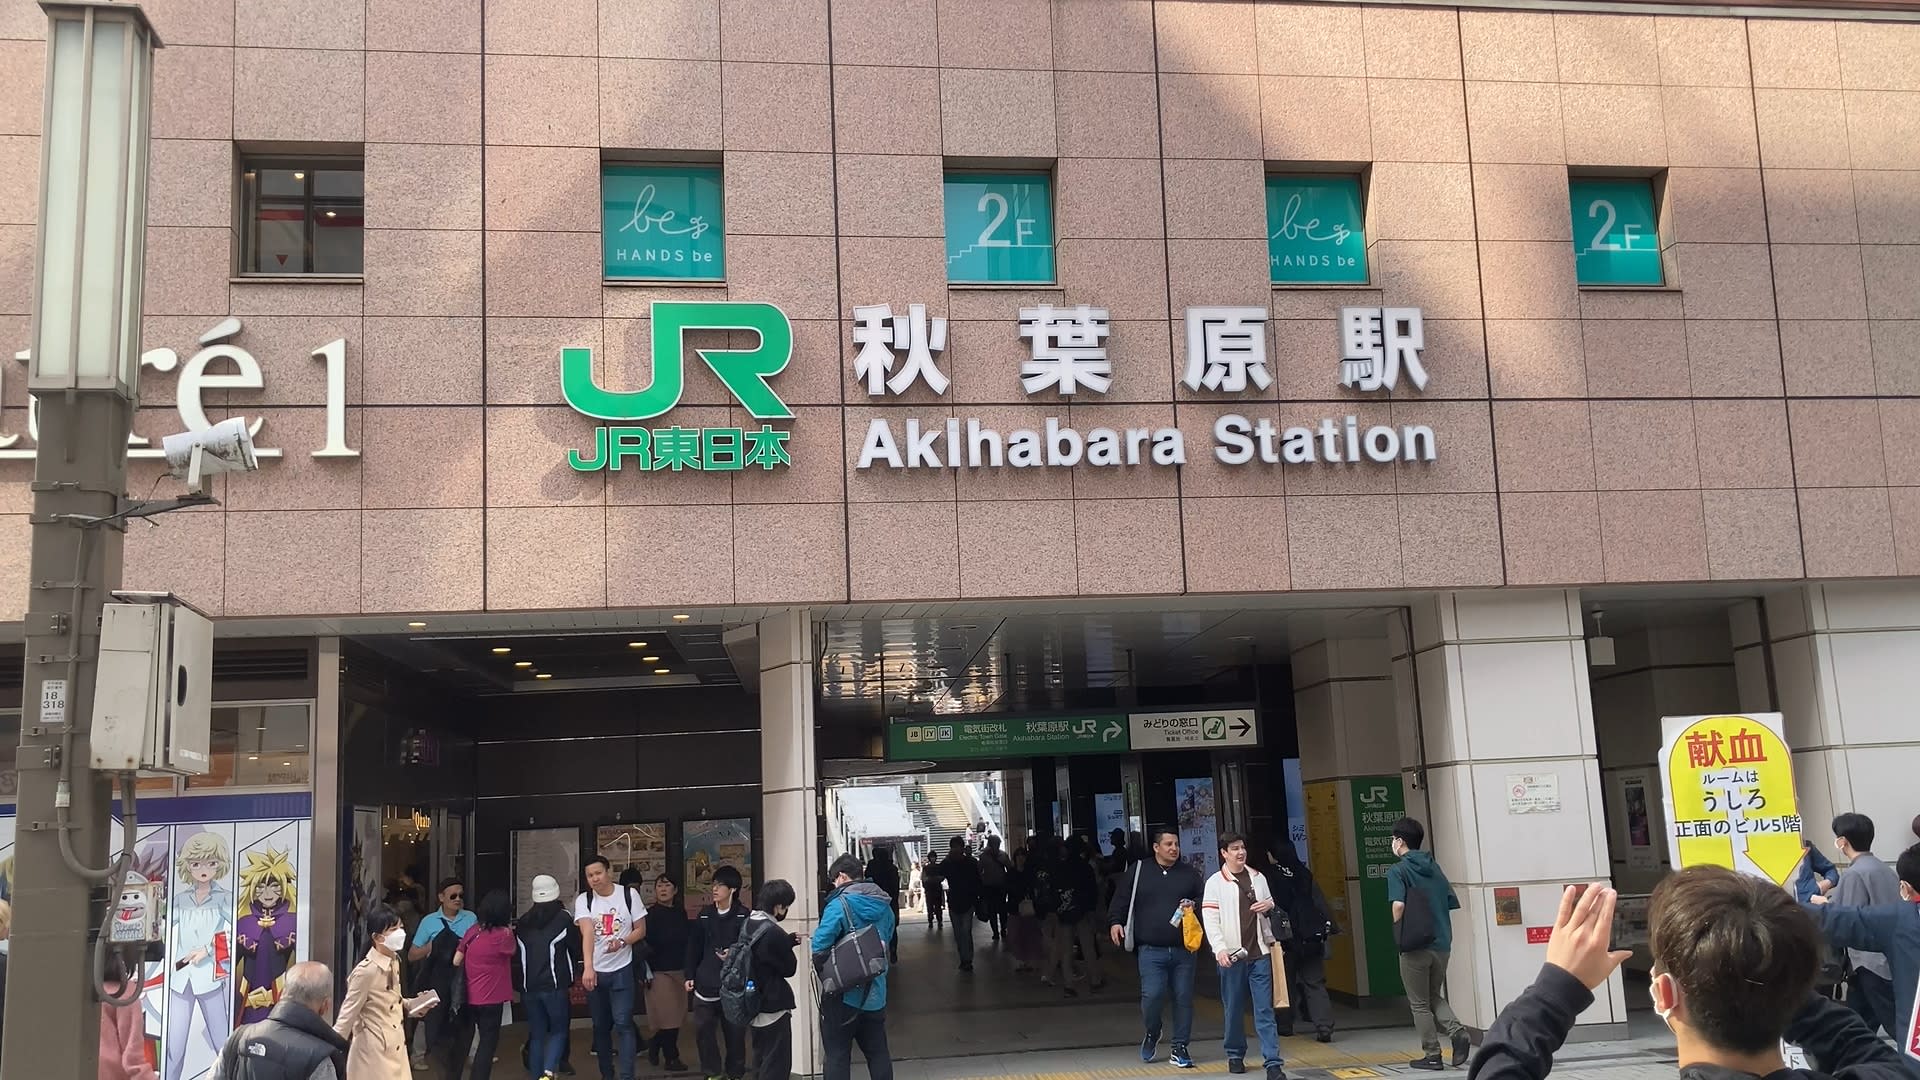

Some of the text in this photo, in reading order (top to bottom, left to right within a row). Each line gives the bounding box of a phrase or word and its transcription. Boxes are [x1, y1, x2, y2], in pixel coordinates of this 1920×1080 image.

[977, 192, 1036, 247] 2F
[1588, 199, 1641, 250] 2F
[616, 248, 713, 262] HANDS be
[1270, 255, 1356, 267] HANDS be
[852, 302, 1429, 397] 秋葉原駅
[560, 300, 796, 420] JR
[567, 425, 792, 472] JR東日本
[855, 413, 1438, 470] Akihabara Station
[42, 700, 65, 709] 318
[44, 691, 58, 700] 18
[1025, 720, 1070, 733] 秋葉原駅
[1072, 719, 1097, 734] JR
[1143, 717, 1198, 729] みどりの窓口
[1046, 733, 1070, 741] Station
[1685, 727, 1768, 769] 献血
[1702, 770, 1760, 785] ルームは
[1359, 785, 1389, 803] JR
[1702, 788, 1767, 813] うしろ
[1674, 814, 1802, 838] 正面のビル5階
